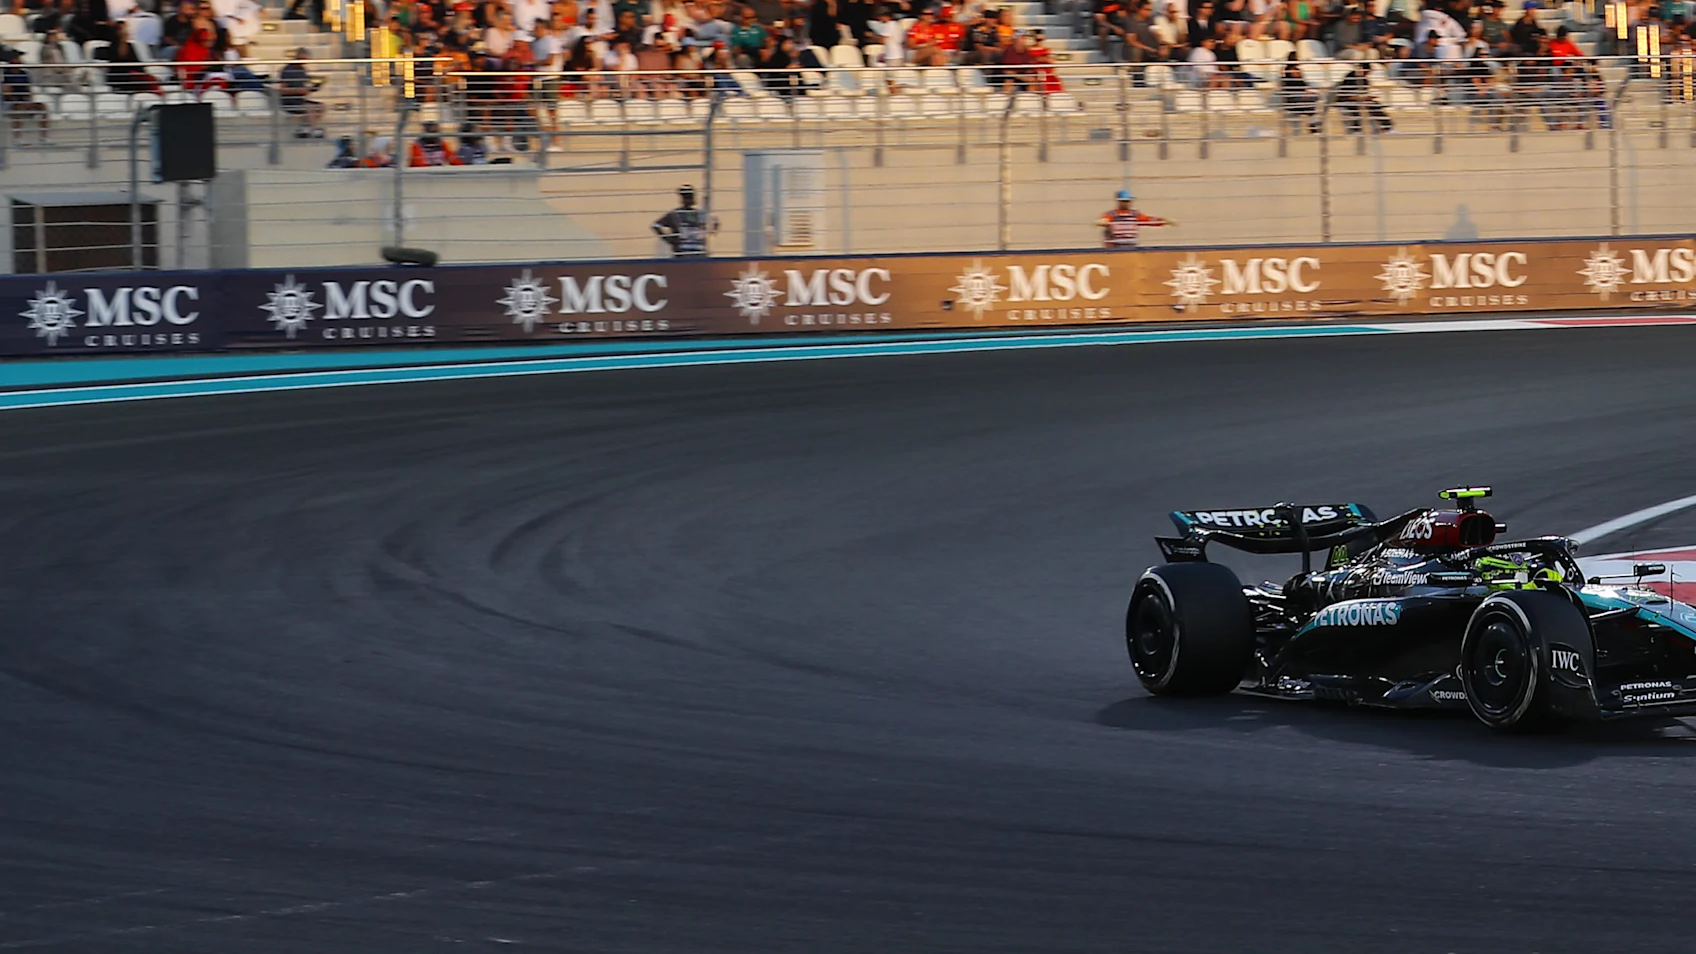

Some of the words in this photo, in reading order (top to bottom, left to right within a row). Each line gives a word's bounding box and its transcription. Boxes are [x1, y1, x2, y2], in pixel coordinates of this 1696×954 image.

[1219, 257, 1321, 295] MSC
[1429, 251, 1528, 289] MSC
[784, 268, 892, 307] MSC
[1006, 263, 1110, 302] MSC
[323, 279, 436, 319] MSC
[559, 274, 668, 314] MSC
[1429, 294, 1529, 307] CRUISES
[84, 286, 199, 327] MSC
[1007, 308, 1111, 320] CRUISES
[1220, 300, 1322, 313] CRUISES
[559, 319, 669, 333] CRUISES
[784, 313, 893, 326] CRUISES
[84, 332, 200, 346] CRUISES
[323, 324, 436, 339] CRUISES
[1195, 506, 1338, 526] PETROAS
[1382, 571, 1428, 585] TeamView
[1314, 602, 1398, 626] PETRONAS
[1552, 650, 1579, 671] IWC
[1620, 681, 1672, 691] PETRONAS
